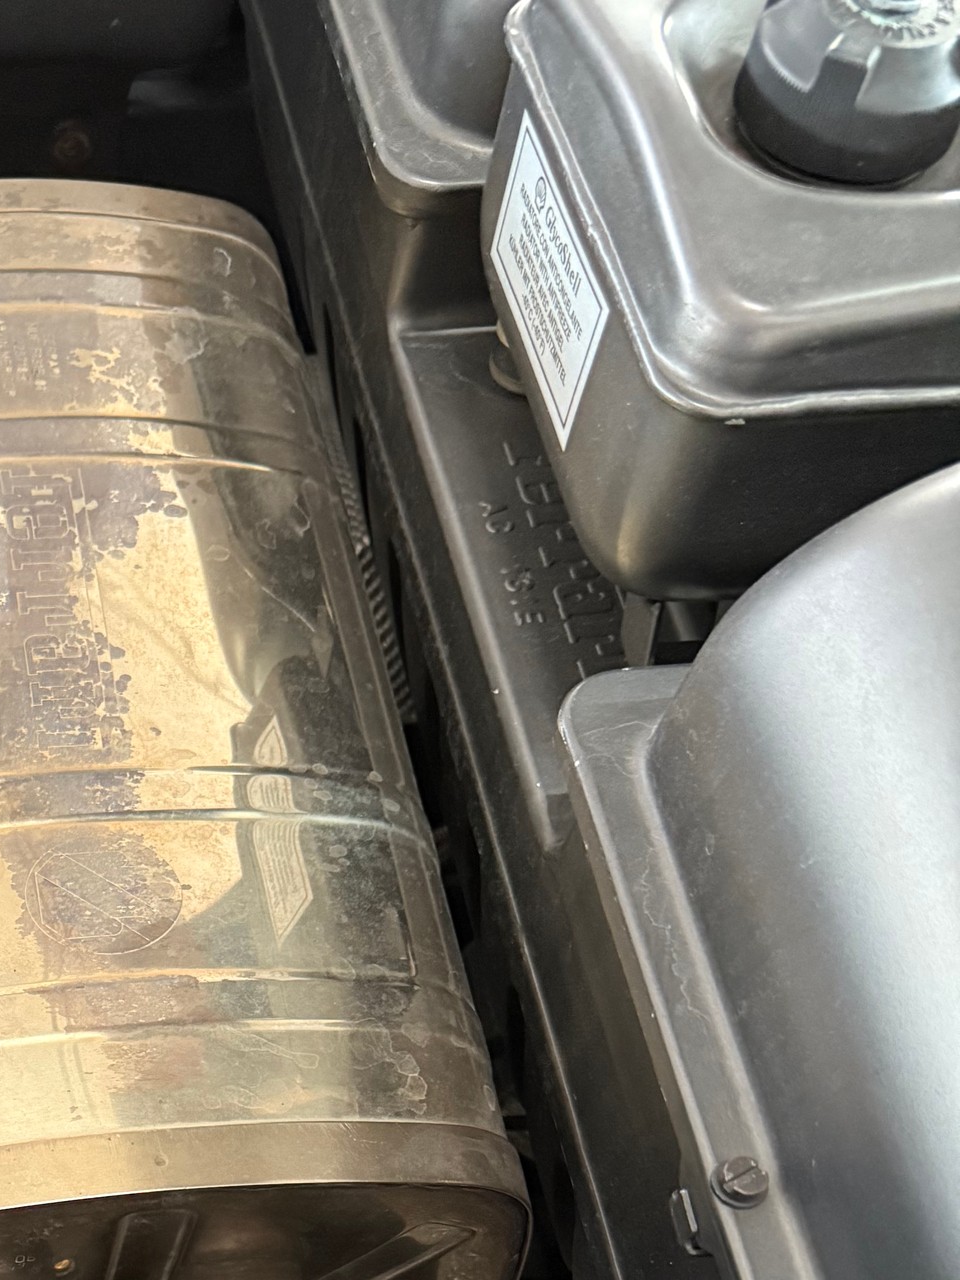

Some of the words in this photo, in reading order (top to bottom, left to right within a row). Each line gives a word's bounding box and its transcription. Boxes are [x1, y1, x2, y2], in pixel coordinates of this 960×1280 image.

[518, 233, 539, 288] RADIATEUR
[537, 283, 549, 313] AVEC
[547, 308, 564, 353] ANTIGEL
[519, 182, 541, 238] RADIATORE
[539, 231, 549, 258] CON
[547, 252, 582, 341] ANTICONGELANTE
[520, 212, 540, 262] RADIATOR
[538, 257, 549, 286] WITH
[547, 281, 571, 342] ANTIFREEZE
[545, 205, 582, 298] GlycoShell
[522, 269, 530, 290] MIT
[528, 285, 567, 387] FROSTSCHUTZMITTEL
